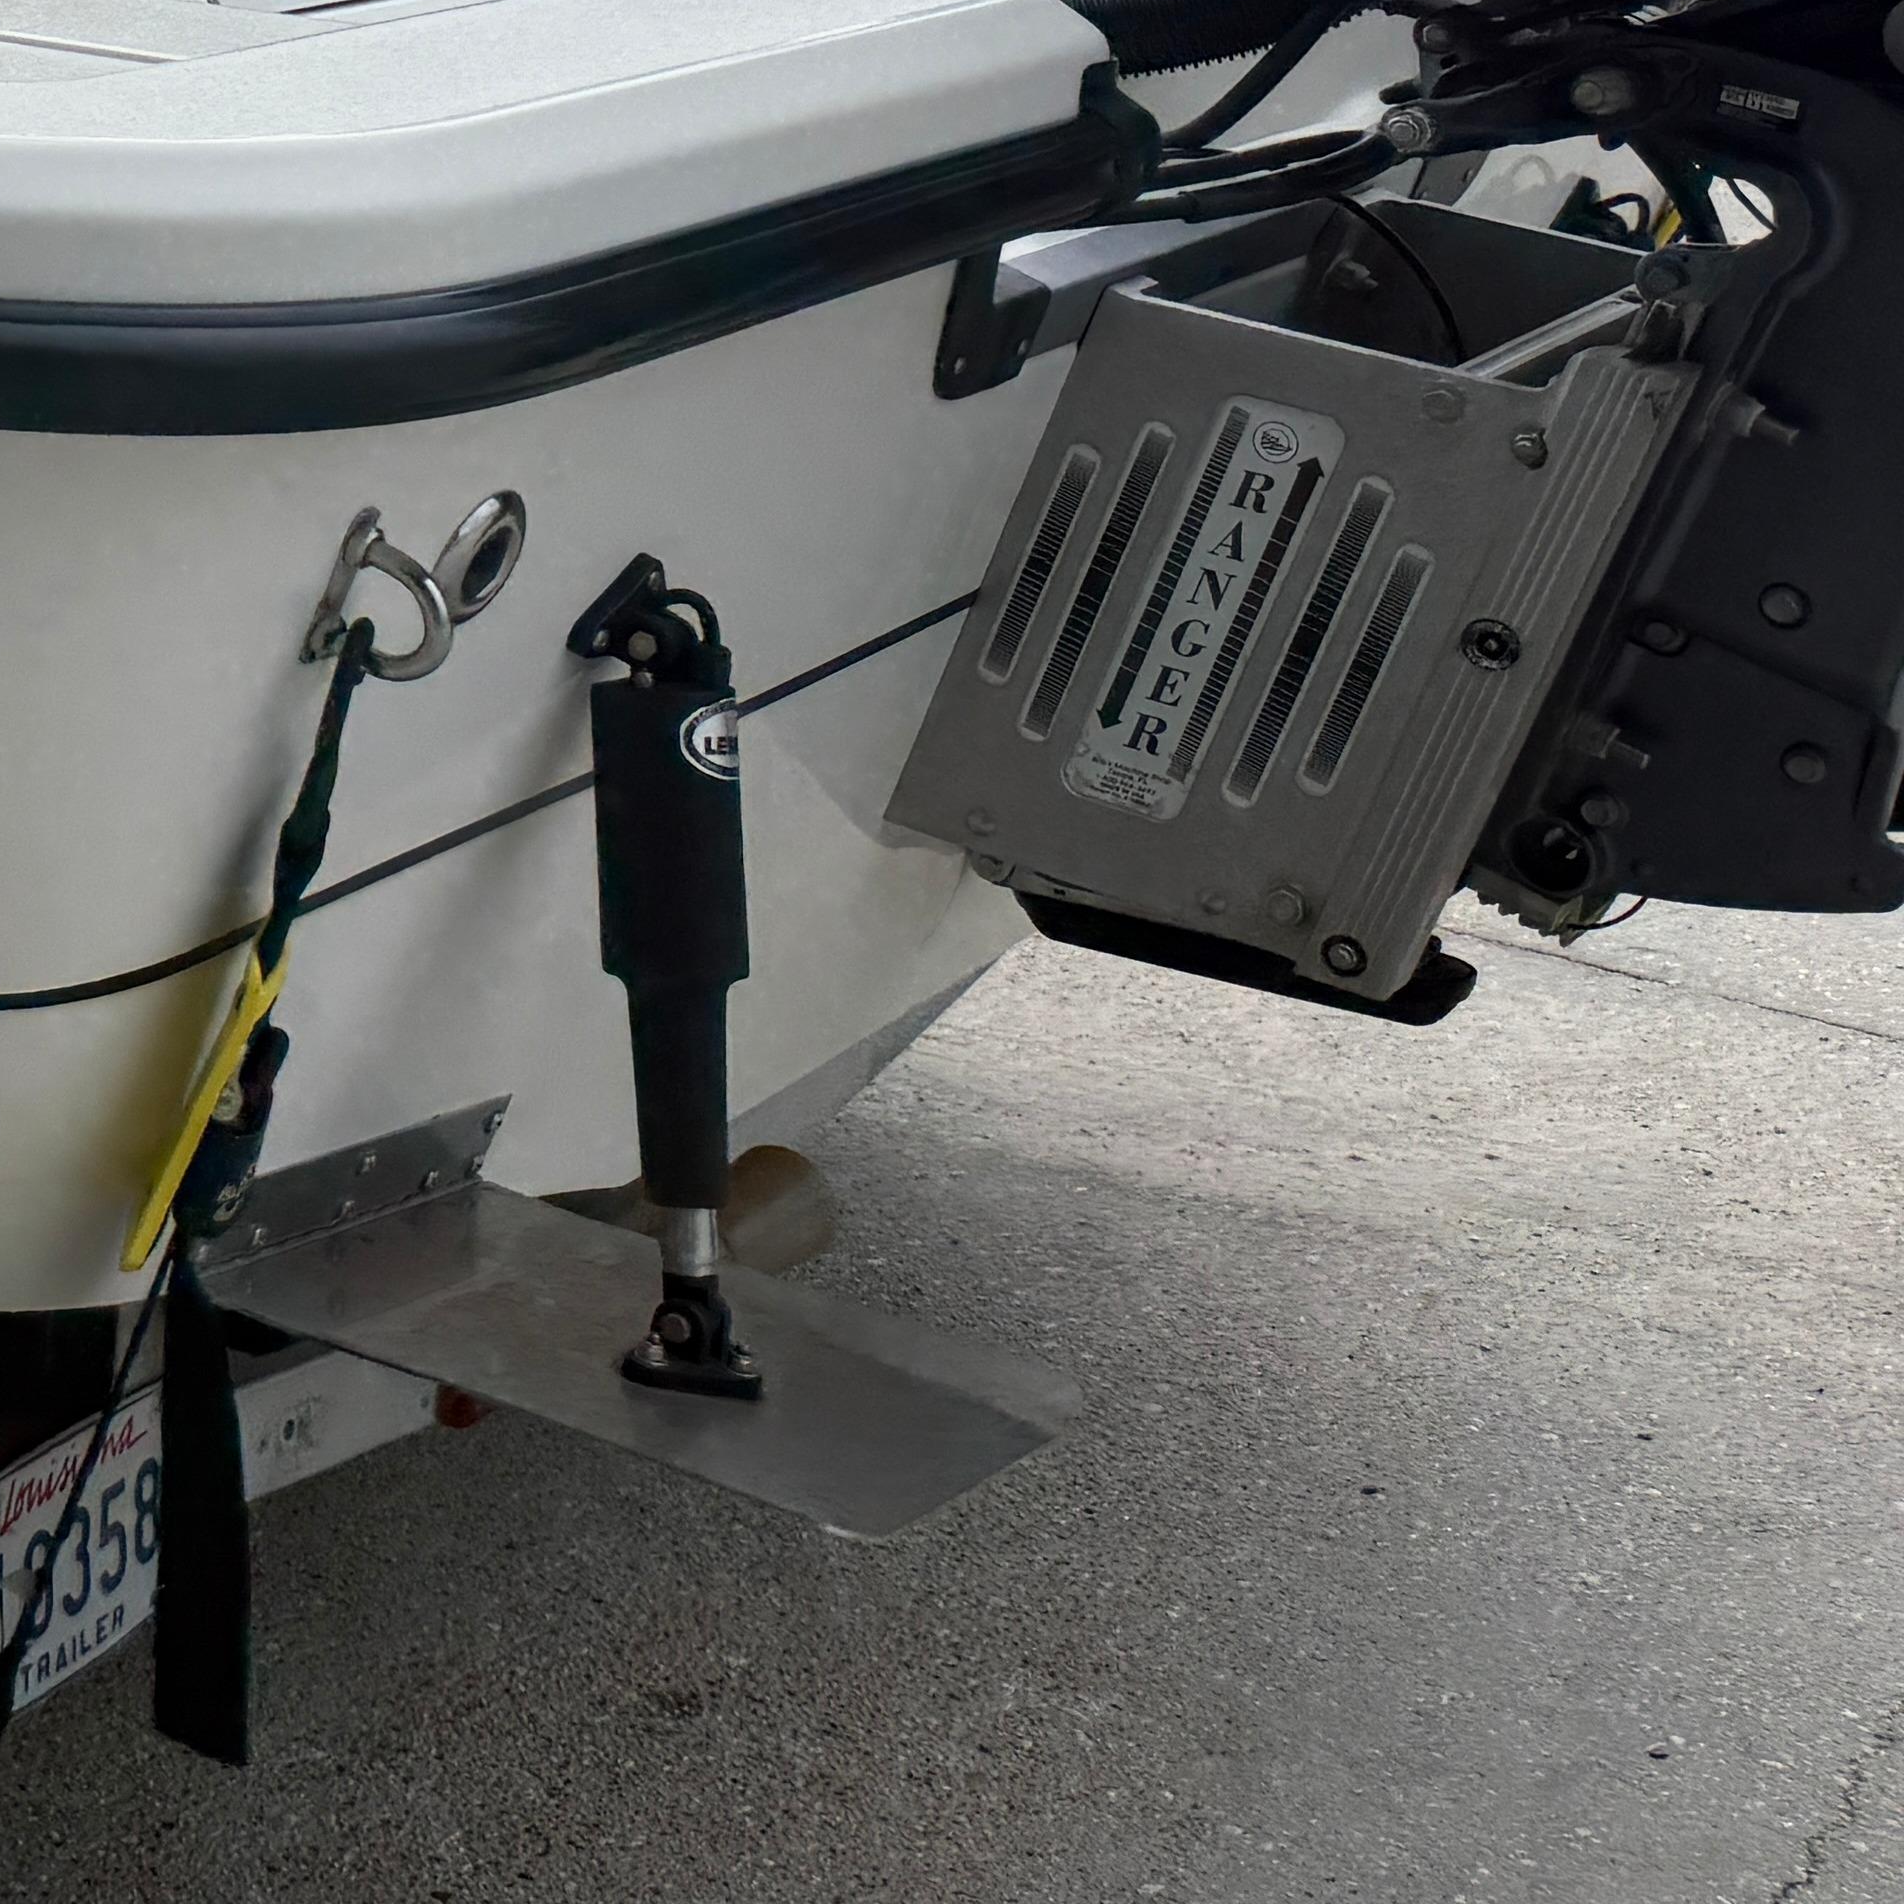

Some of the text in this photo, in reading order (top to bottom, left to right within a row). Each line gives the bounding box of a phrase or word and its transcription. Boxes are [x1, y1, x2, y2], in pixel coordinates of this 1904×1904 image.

[1122, 469, 1277, 757] RANGER
[0, 1414, 148, 1537] Louisina
[17, 1603, 125, 1695] TRAILER
